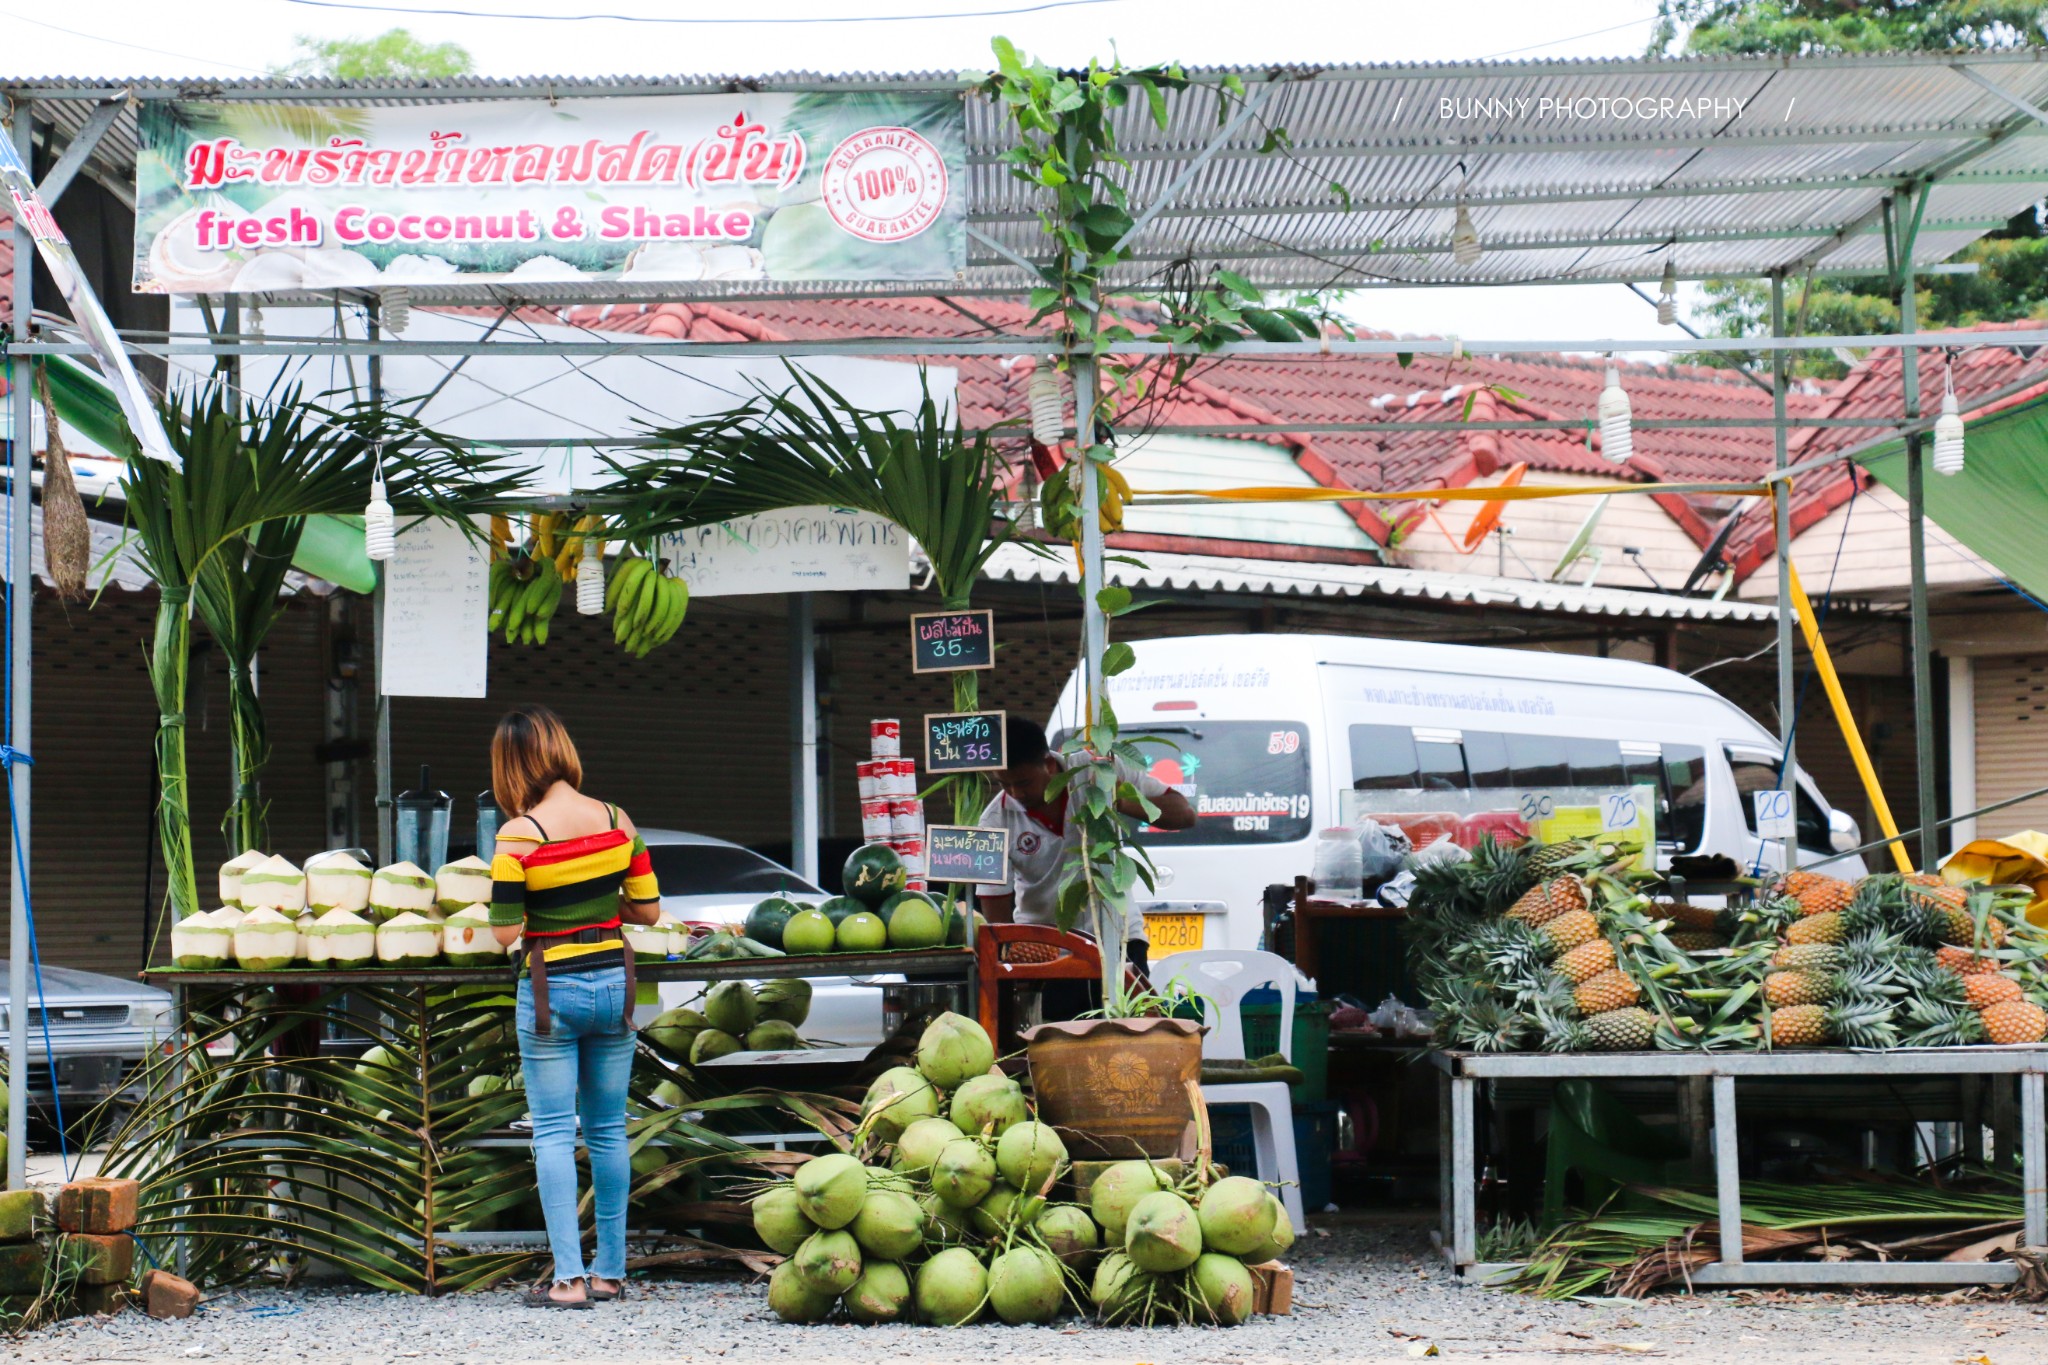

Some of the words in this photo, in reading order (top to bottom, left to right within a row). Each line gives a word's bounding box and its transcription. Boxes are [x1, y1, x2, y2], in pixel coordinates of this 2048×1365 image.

[189, 111, 803, 189] มะพร้าวน้ำหอมสด(ปั่น)
[836, 133, 922, 169] GUARANTEE
[853, 164, 917, 202] 100%
[196, 208, 318, 246] fresh
[334, 206, 537, 241] Coconut
[551, 205, 584, 239] &
[601, 205, 751, 239] Shake
[845, 201, 932, 234] GUARANTEE
[1268, 731, 1299, 754] 59
[1290, 795, 1310, 819] 19
[1521, 793, 1551, 820] 30
[1608, 793, 1636, 828] 25
[1758, 791, 1790, 821] 20
[1233, 816, 1270, 831] ตราด
